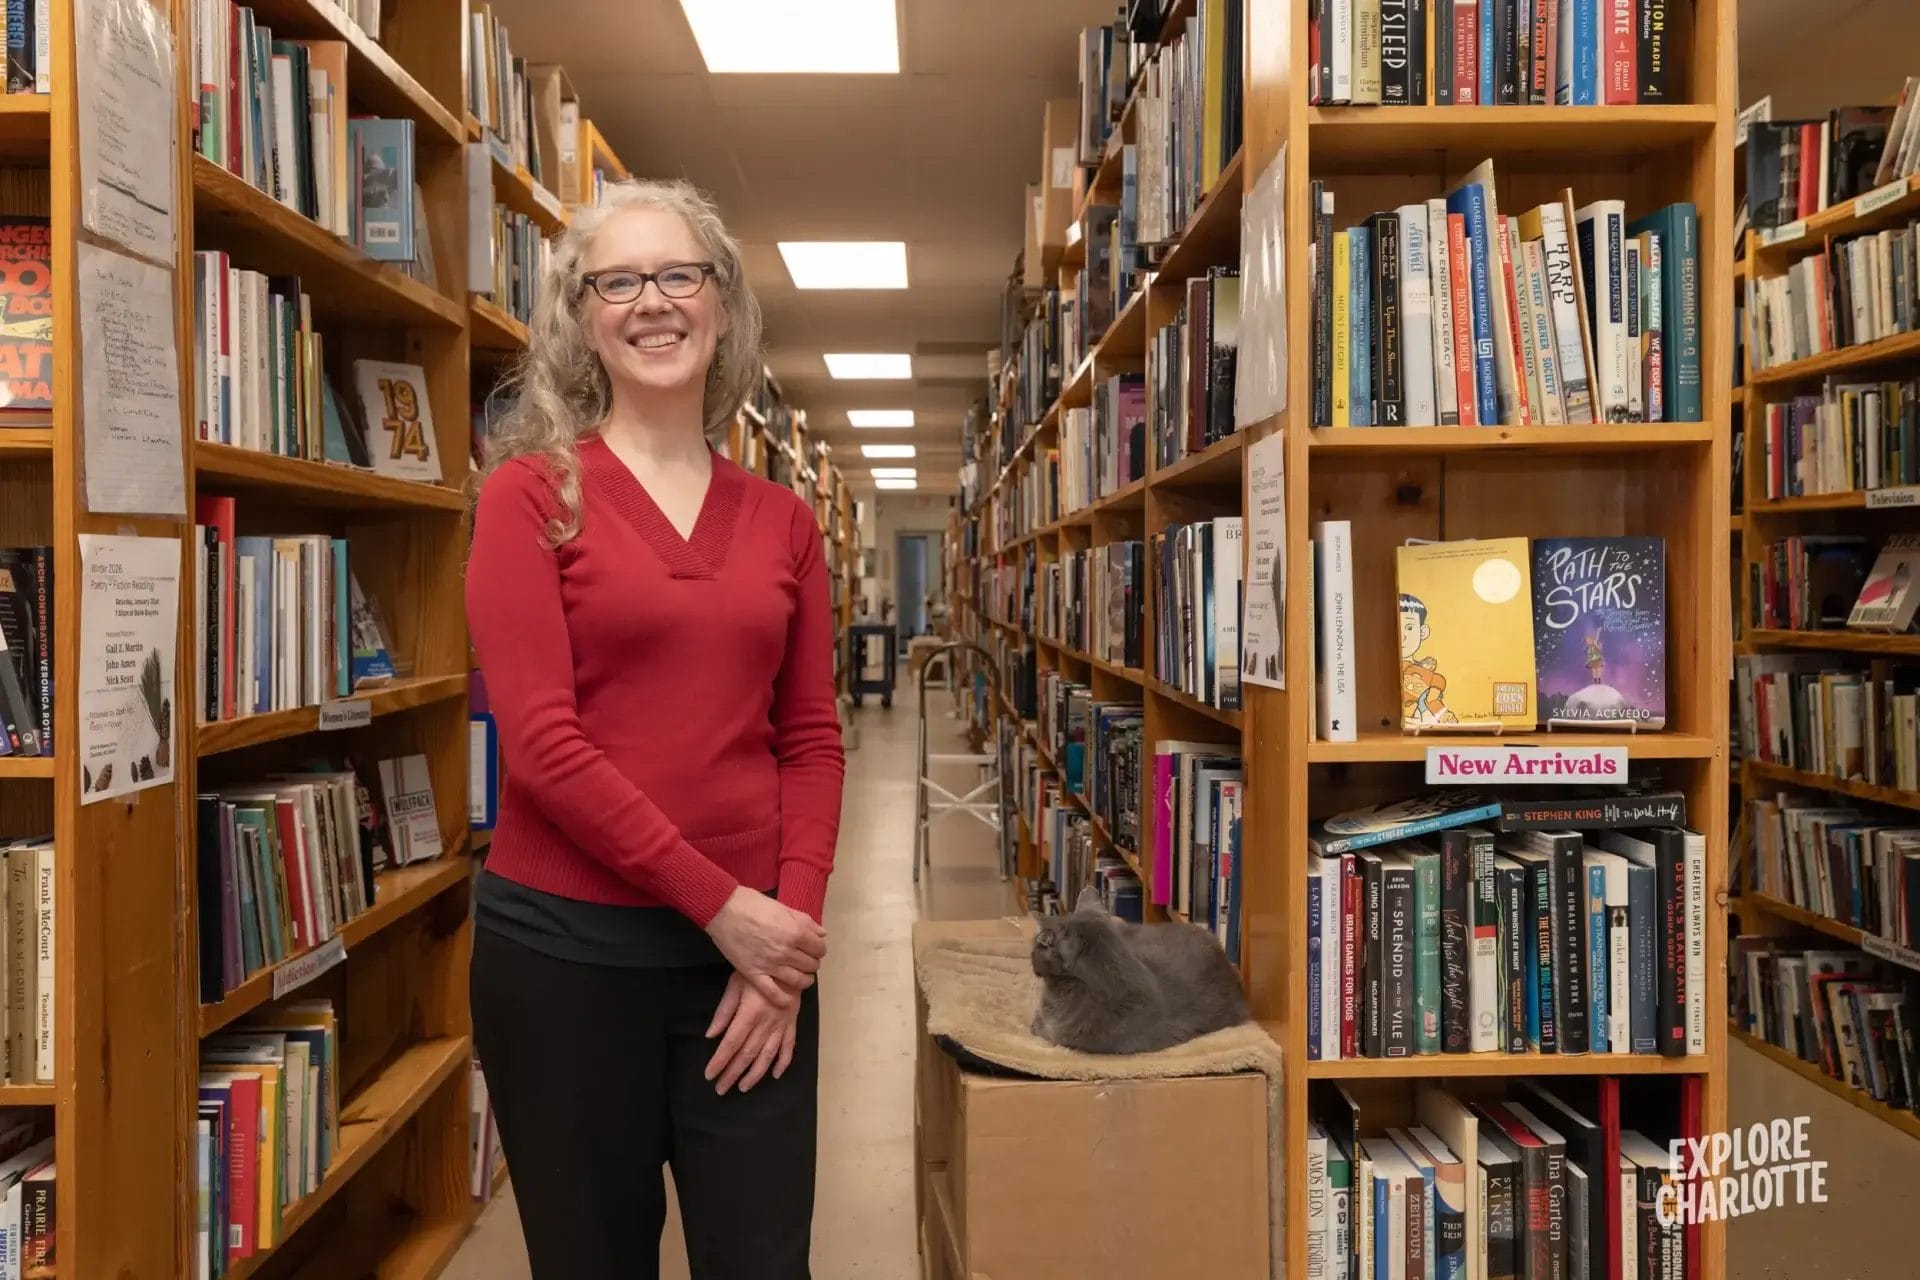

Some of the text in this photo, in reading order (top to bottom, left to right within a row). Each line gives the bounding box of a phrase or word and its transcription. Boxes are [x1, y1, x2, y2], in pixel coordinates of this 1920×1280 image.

[1360, 11, 1370, 68] Birmingham
[1466, 12, 1474, 28] THE
[1382, 13, 1406, 69] SLEEP
[1466, 32, 1474, 66] MIDDLE
[1652, 35, 1660, 73] READER
[1535, 59, 1546, 90] MAAS
[1614, 60, 1622, 92] Okrent
[1556, 242, 1576, 305] HARD
[1609, 216, 1621, 320] ENRIQUE'S JOURNEY
[1650, 235, 1660, 273] MALALA
[1531, 272, 1544, 308] STREET
[1547, 249, 1564, 300] LINE
[1682, 257, 1696, 326] BECOMING
[1439, 240, 1452, 368] AN ENDURING LEGACY
[1457, 287, 1467, 323] BEYOND
[1473, 196, 1493, 395] CHARLESTON'S GREEK HERITAGE MORRIS
[1384, 306, 1396, 376] Upon These Shores
[1536, 313, 1549, 351] CORNER
[1683, 327, 1696, 345] Dr.
[1683, 346, 1696, 357] Q
[1459, 334, 1470, 373] BORDER
[1651, 352, 1661, 366] ARE
[1543, 357, 1556, 397] SOCIETY
[1652, 367, 1662, 406] DISPLACED
[1871, 492, 1914, 505] Television
[91, 563, 108, 575] Winter
[1546, 546, 1634, 585] PATH TO THE
[90, 580, 108, 593] Poetry
[131, 580, 155, 593] Reading
[1545, 572, 1642, 629] STARS
[37, 555, 51, 739] ARCH-CONSPIRATOR VERONICA ROTH
[105, 644, 118, 654] Gail
[125, 642, 144, 653] Martin
[105, 660, 120, 673] John
[105, 676, 119, 686] Nick
[1552, 707, 1650, 719] SYLVIA ACEVEDO
[1438, 752, 1617, 775] New Arrivals
[1524, 809, 1572, 822] STEPHEN
[1575, 808, 1602, 820] KING
[1484, 843, 1495, 904] IN DEADLY COMBAT
[16, 900, 25, 944] FRANK
[40, 867, 52, 961] Frank McCourt
[1311, 887, 1320, 927] LATIFA
[1370, 882, 1379, 940] LIVING PROOF
[1693, 859, 1701, 957] CHEATERS ALWAYS WIN
[1393, 910, 1404, 978] SPLENDID
[1536, 868, 1553, 1037] TOM WOLFE THE ELECTRIC KOOL-AID ACID TEST
[1567, 891, 1579, 1004] HUMANS OF NEW YORK
[1675, 862, 1686, 1004] DEVIL'S BARGAIN
[1345, 913, 1355, 1022] BRAIN GAMES FOR DOGS
[1441, 907, 1465, 1010] Velvet Was the Night
[41, 992, 49, 1029] Teacher
[1392, 1010, 1403, 1039] VILE
[1549, 1154, 1564, 1179] Ina
[24, 1203, 32, 1236] Caroline
[1307, 1151, 1328, 1279] AMOS ELON Jerusalem
[1490, 1177, 1502, 1234] KING
[1504, 1176, 1513, 1232] STEPHEN
[1549, 1184, 1565, 1241] Garten
[35, 1188, 46, 1273] PRAIRIE FIRES
[1411, 1193, 1421, 1259] ZEITOUN
[1443, 1222, 1462, 1230] THIN
[1443, 1231, 1462, 1239] SKIN
[1662, 1237, 1672, 1280] MODERN
[1672, 1232, 1683, 1280] PERSONAL
